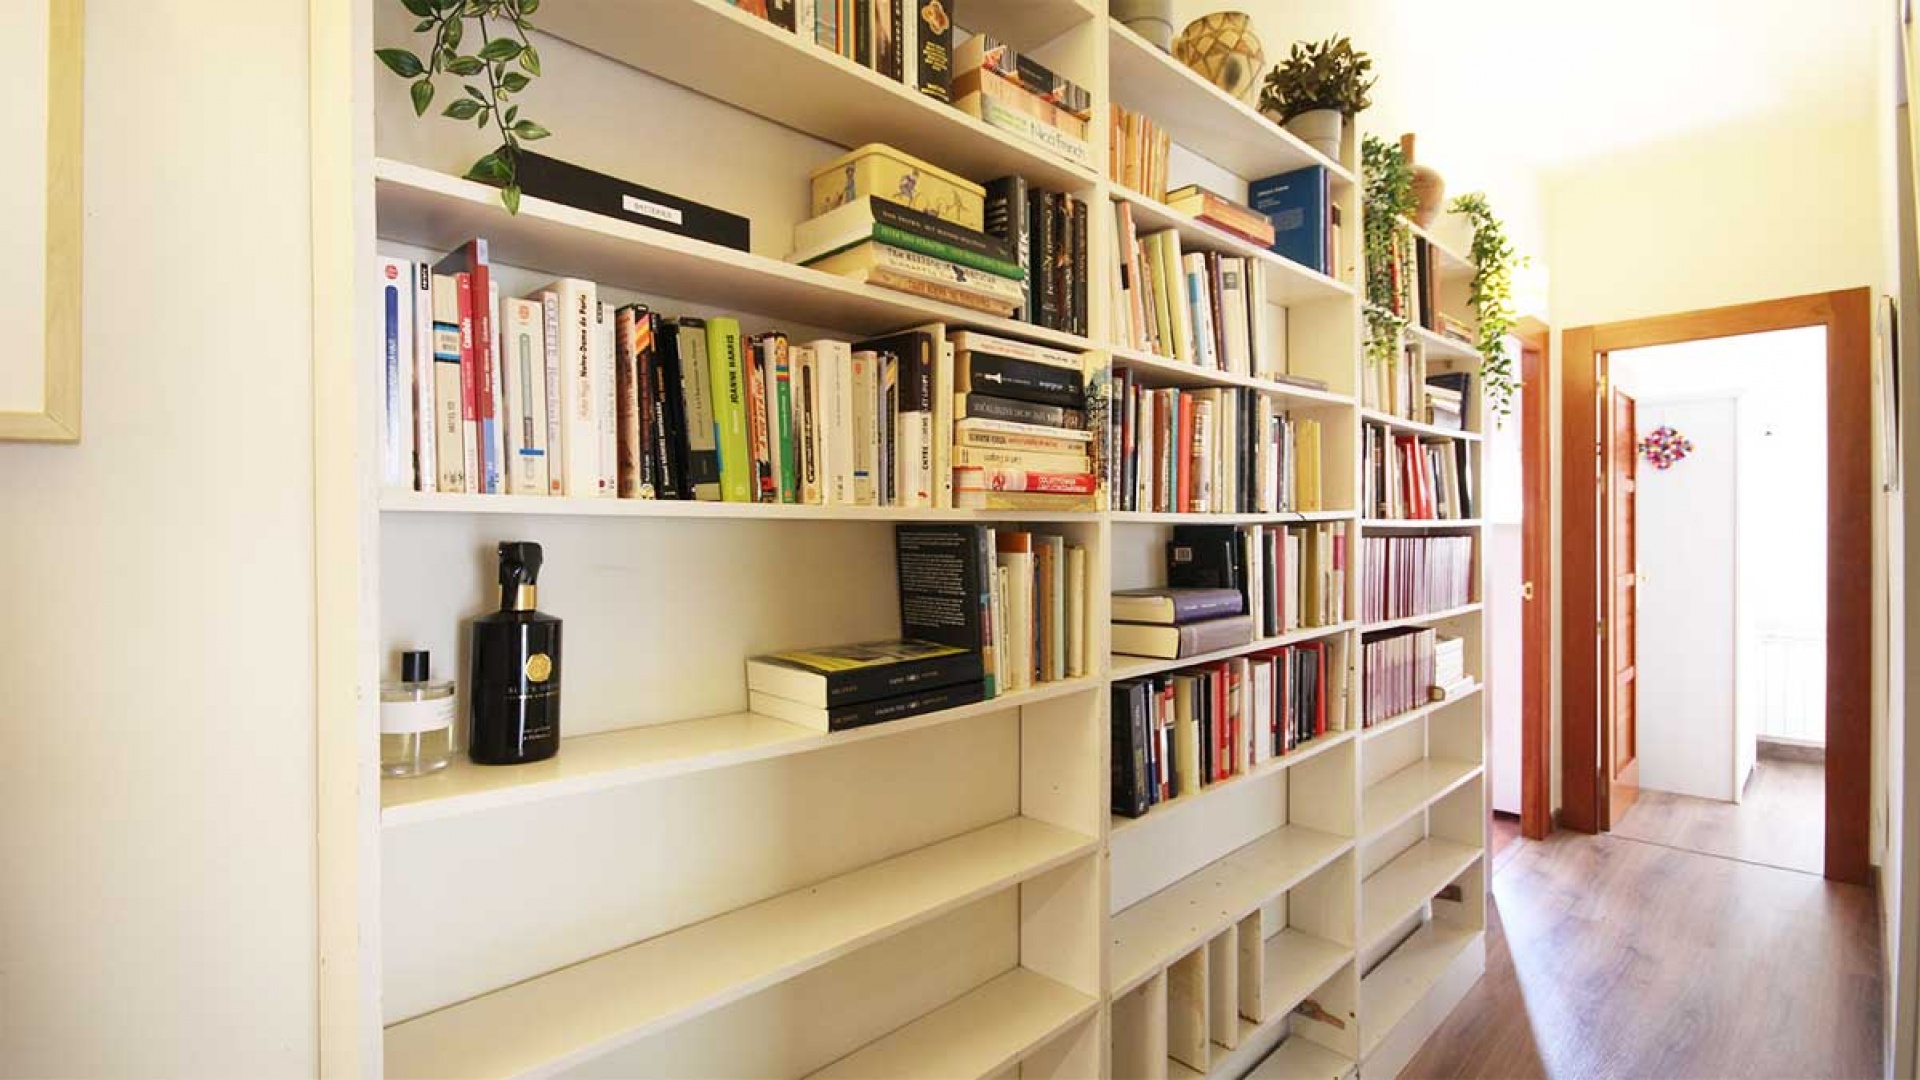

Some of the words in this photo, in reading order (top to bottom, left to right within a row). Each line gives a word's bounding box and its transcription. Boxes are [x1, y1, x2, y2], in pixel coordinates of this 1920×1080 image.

[579, 294, 587, 315] Paris
[462, 317, 472, 348] Candide
[579, 329, 588, 377] Notre-Dame
[726, 334, 737, 368] HARRIS
[729, 370, 739, 403] JOANNE
